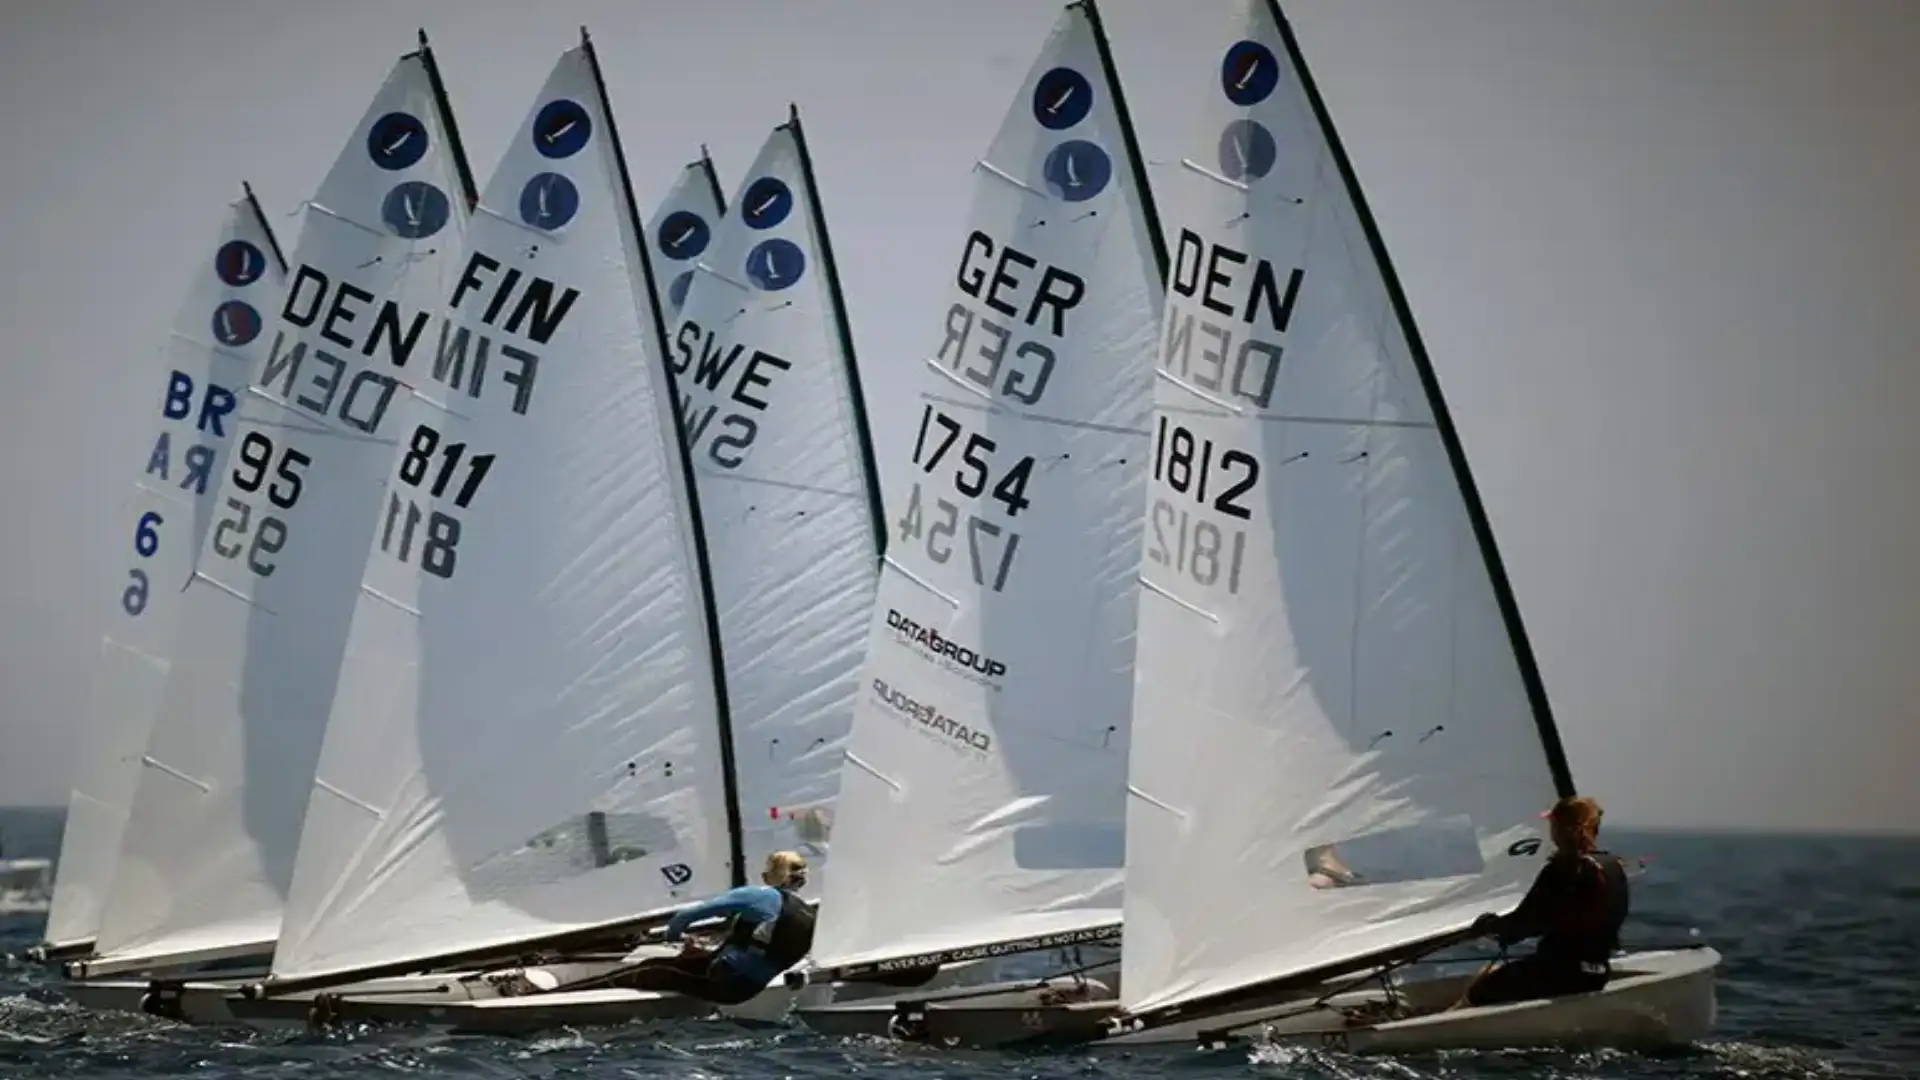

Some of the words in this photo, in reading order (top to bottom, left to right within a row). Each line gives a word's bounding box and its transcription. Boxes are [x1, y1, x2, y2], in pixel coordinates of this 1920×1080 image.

[282, 264, 430, 367] DEN
[449, 251, 580, 345] FIN
[957, 230, 1085, 337] GER
[1173, 228, 1305, 333] DEN
[670, 320, 792, 411] SWE
[232, 431, 312, 509] 95
[400, 424, 496, 509] 811
[912, 404, 1035, 517] 1754
[1154, 415, 1260, 520] 1812
[135, 511, 164, 557] 6
[886, 609, 1007, 677] DATAGROUP
[878, 957, 916, 971] NEVER
[917, 953, 941, 966] QUIT
[990, 937, 1040, 955] QUITTING
[1054, 931, 1075, 944] NOT
